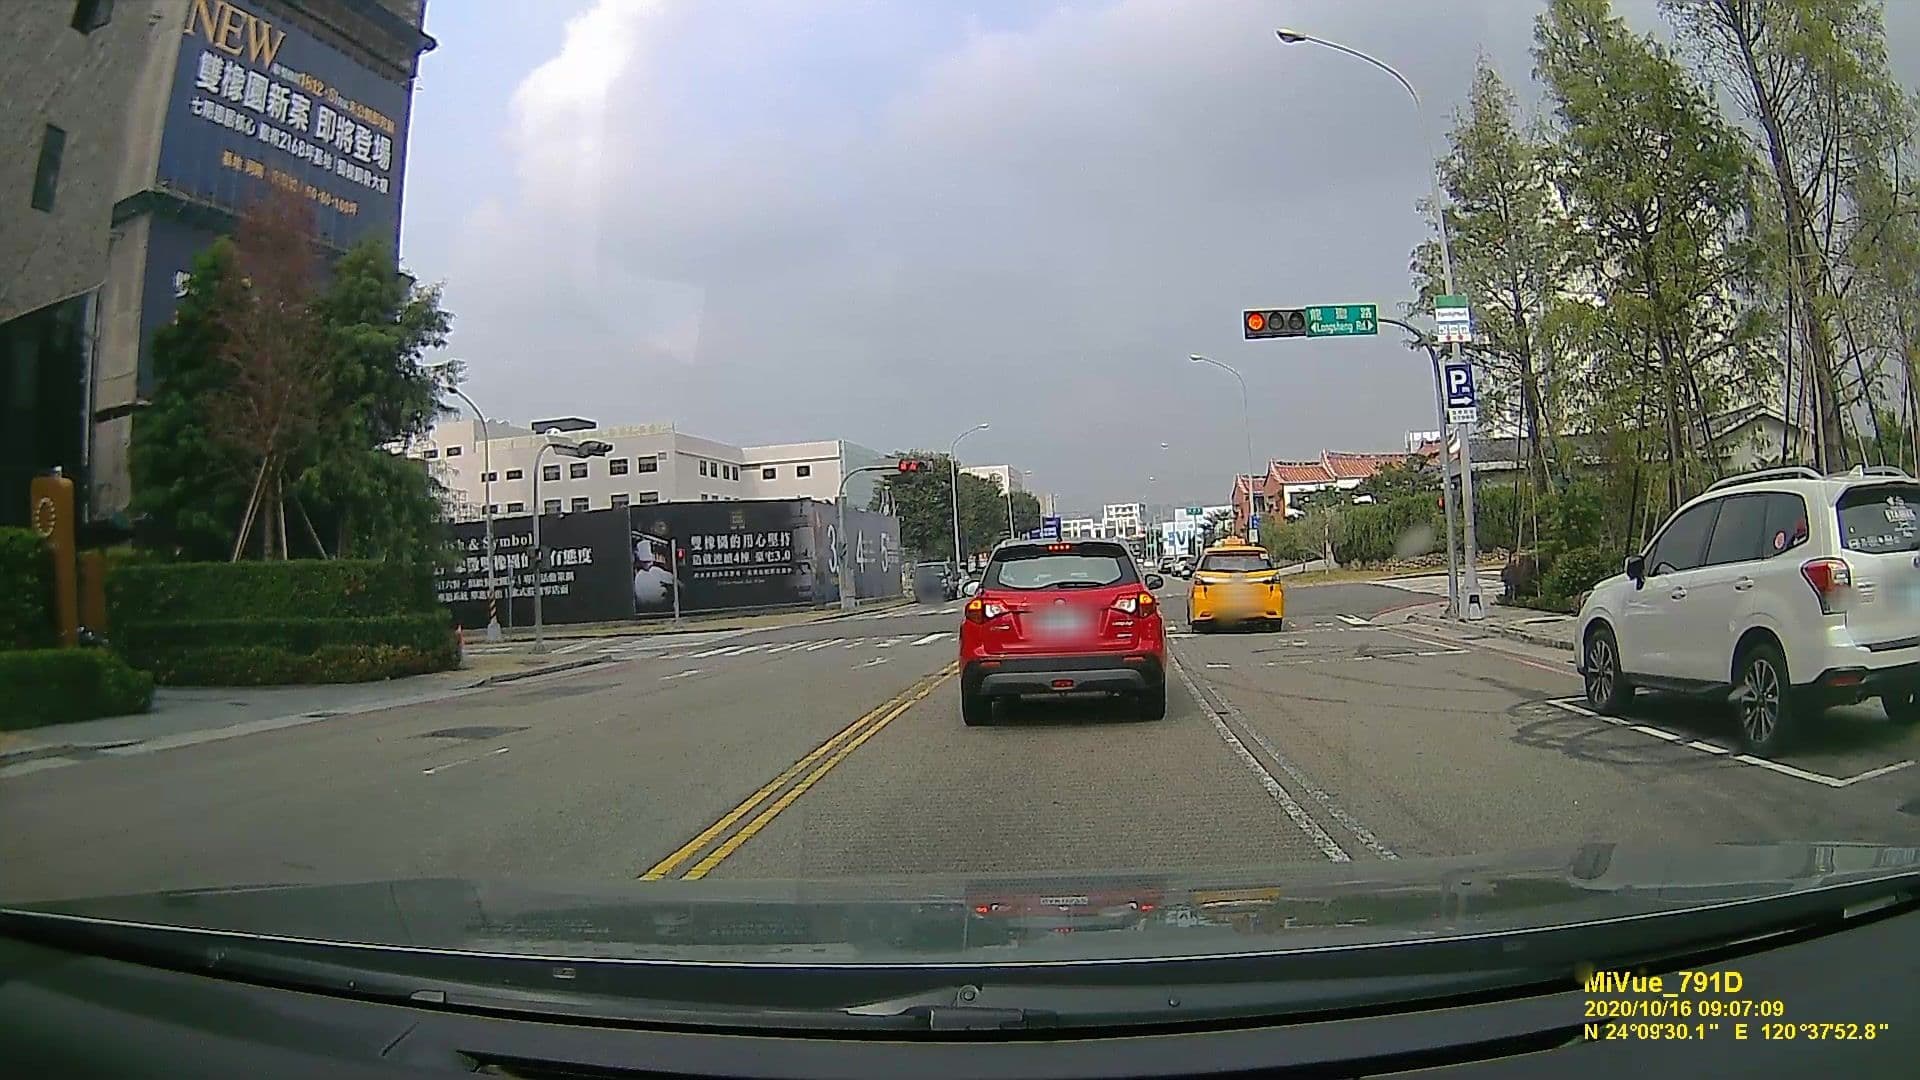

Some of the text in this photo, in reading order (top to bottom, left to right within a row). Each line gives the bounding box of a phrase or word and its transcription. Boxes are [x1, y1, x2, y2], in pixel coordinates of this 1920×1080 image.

[183, 0, 286, 68] NEW
[314, 103, 393, 171] 即將登場
[1450, 369, 1467, 394] P
